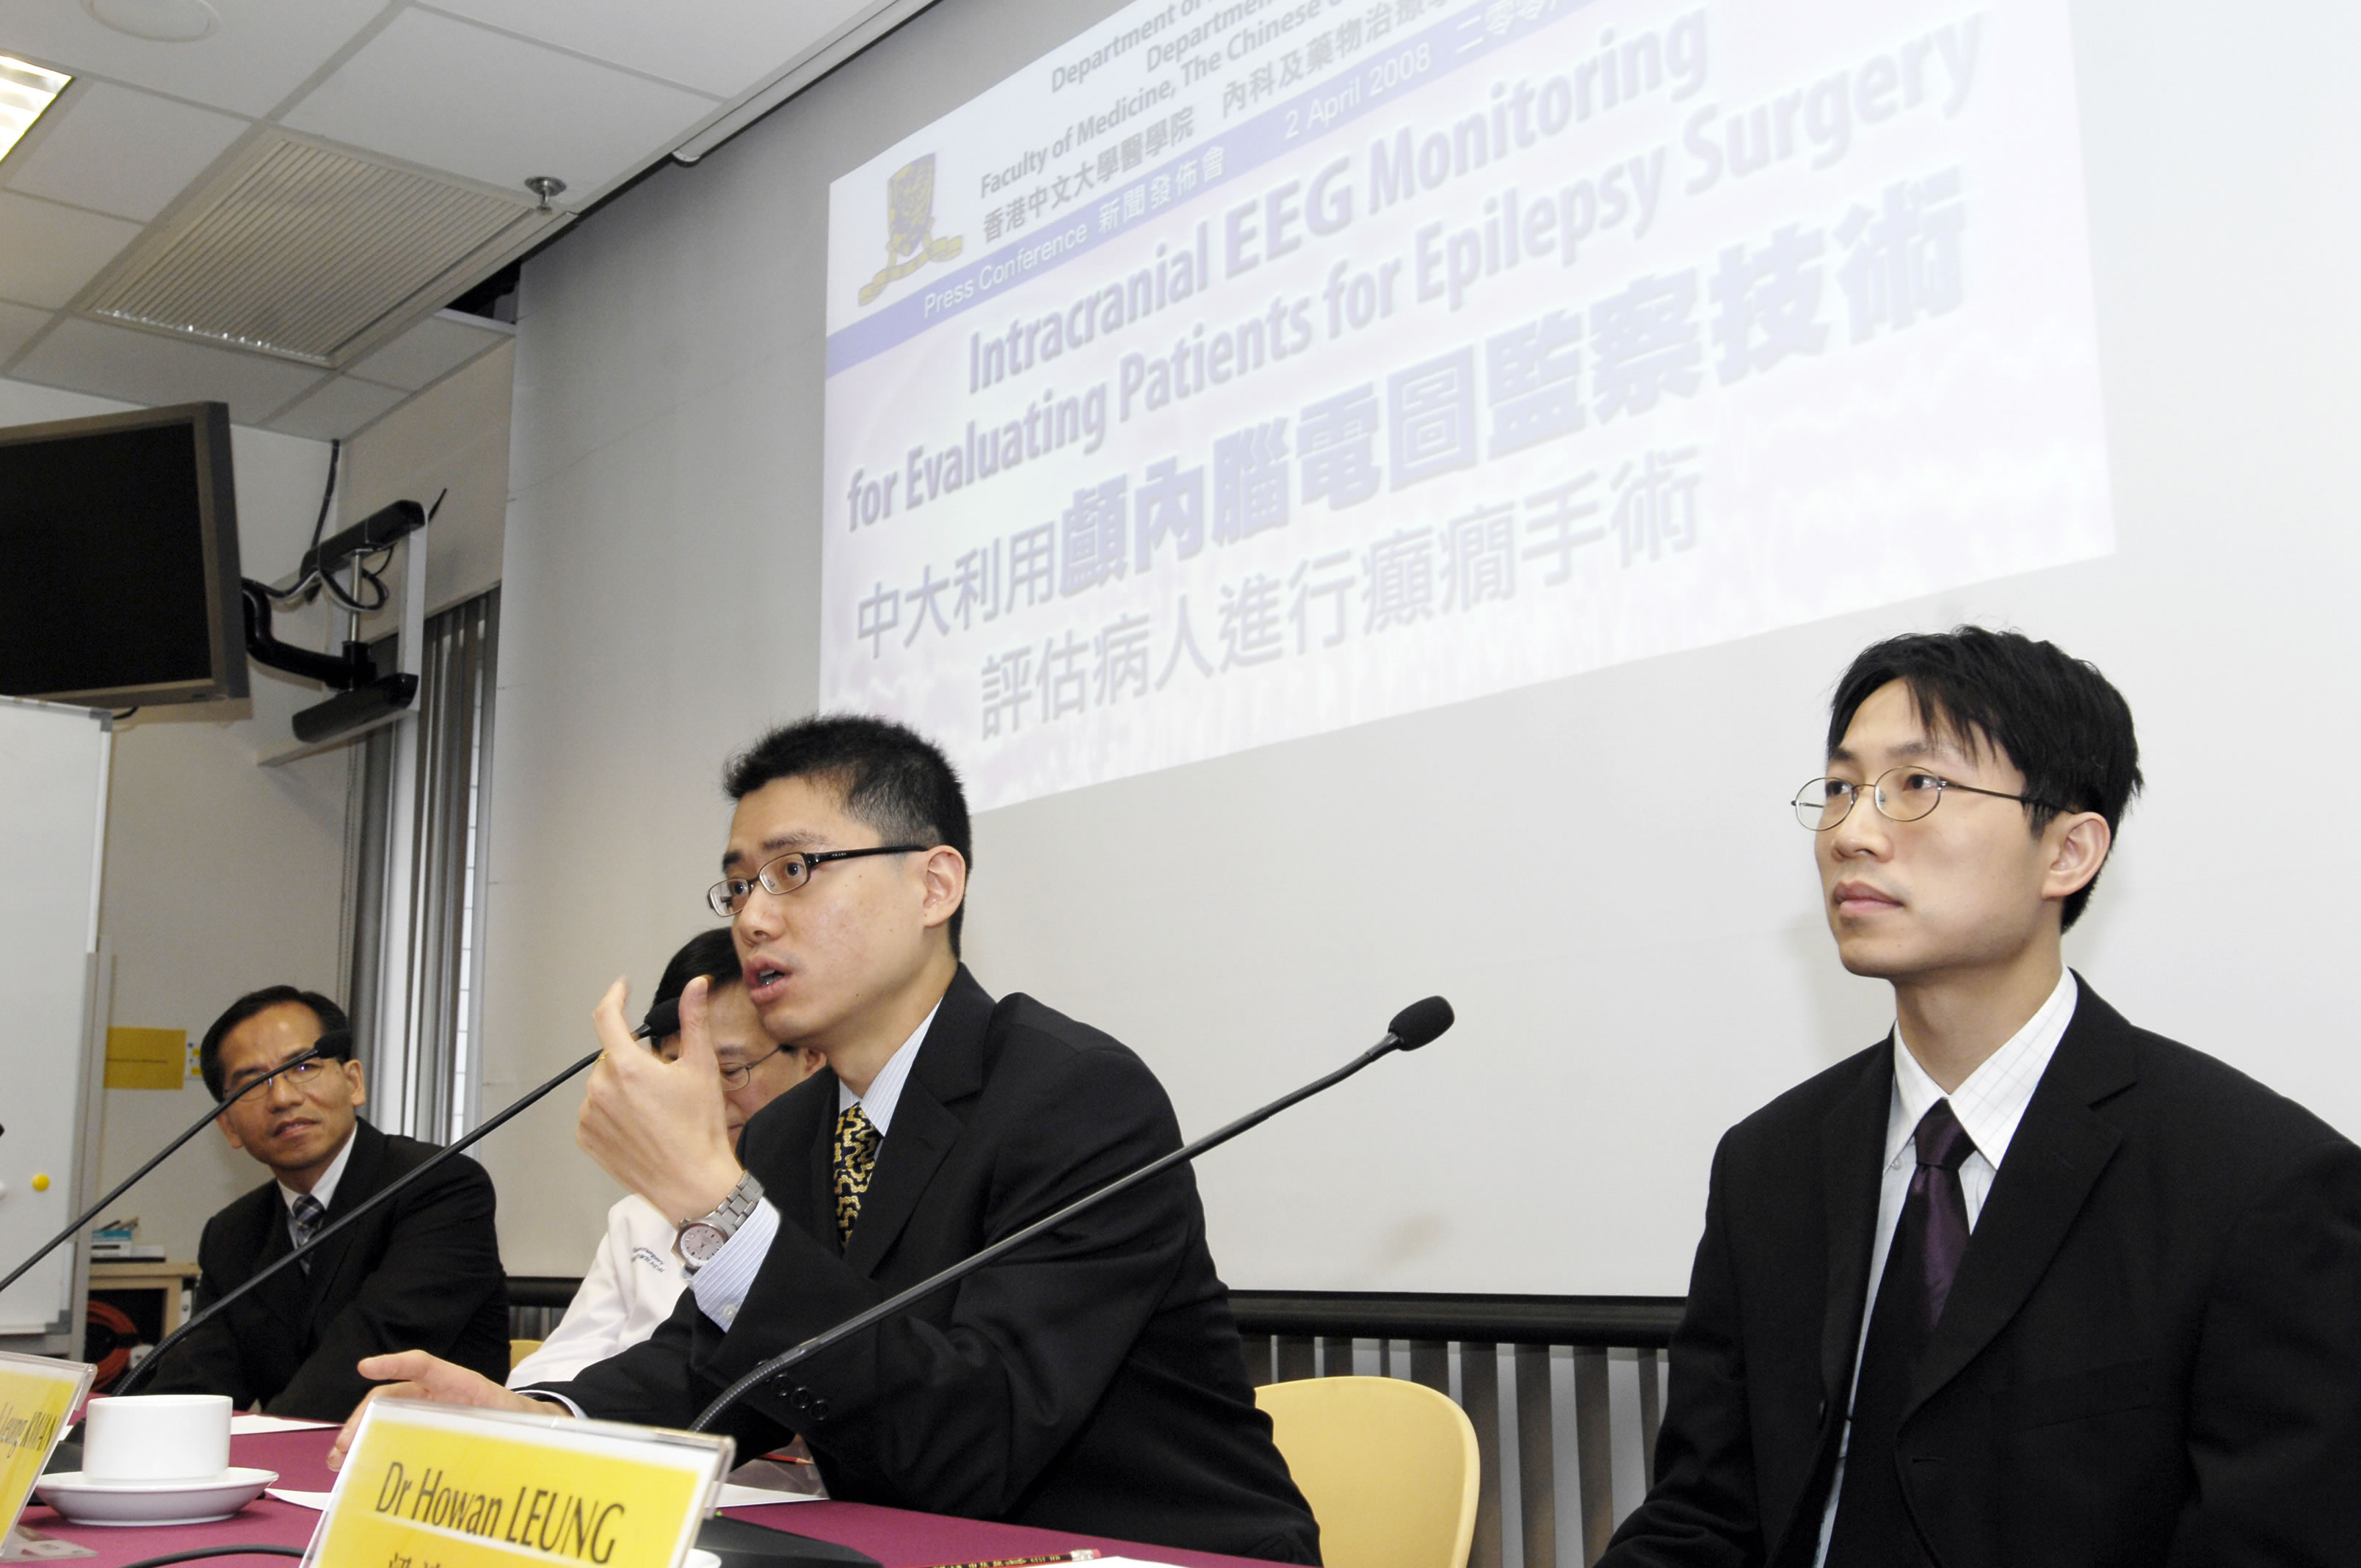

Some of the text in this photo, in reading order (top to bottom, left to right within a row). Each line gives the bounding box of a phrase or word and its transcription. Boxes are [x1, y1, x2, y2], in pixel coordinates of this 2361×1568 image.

[980, 0, 1321, 199] Faculty of Medicine, The Chinese
[1051, 4, 1176, 93] Department
[847, 11, 1984, 532] for Evaluating Patients for Epilepsy Surgery
[924, 278, 975, 320] Press
[979, 223, 1087, 290] Conference
[1098, 145, 1225, 235] 新聞發佈會
[1285, 111, 1301, 140] 2
[1306, 76, 1361, 130] April
[1368, 42, 1432, 97] 2008
[969, 8, 1708, 394] Intracranial EEG Monitoring
[983, 105, 1194, 244] 香港中文大學醫學院
[375, 1462, 625, 1565] Dr Howan LEUNG
